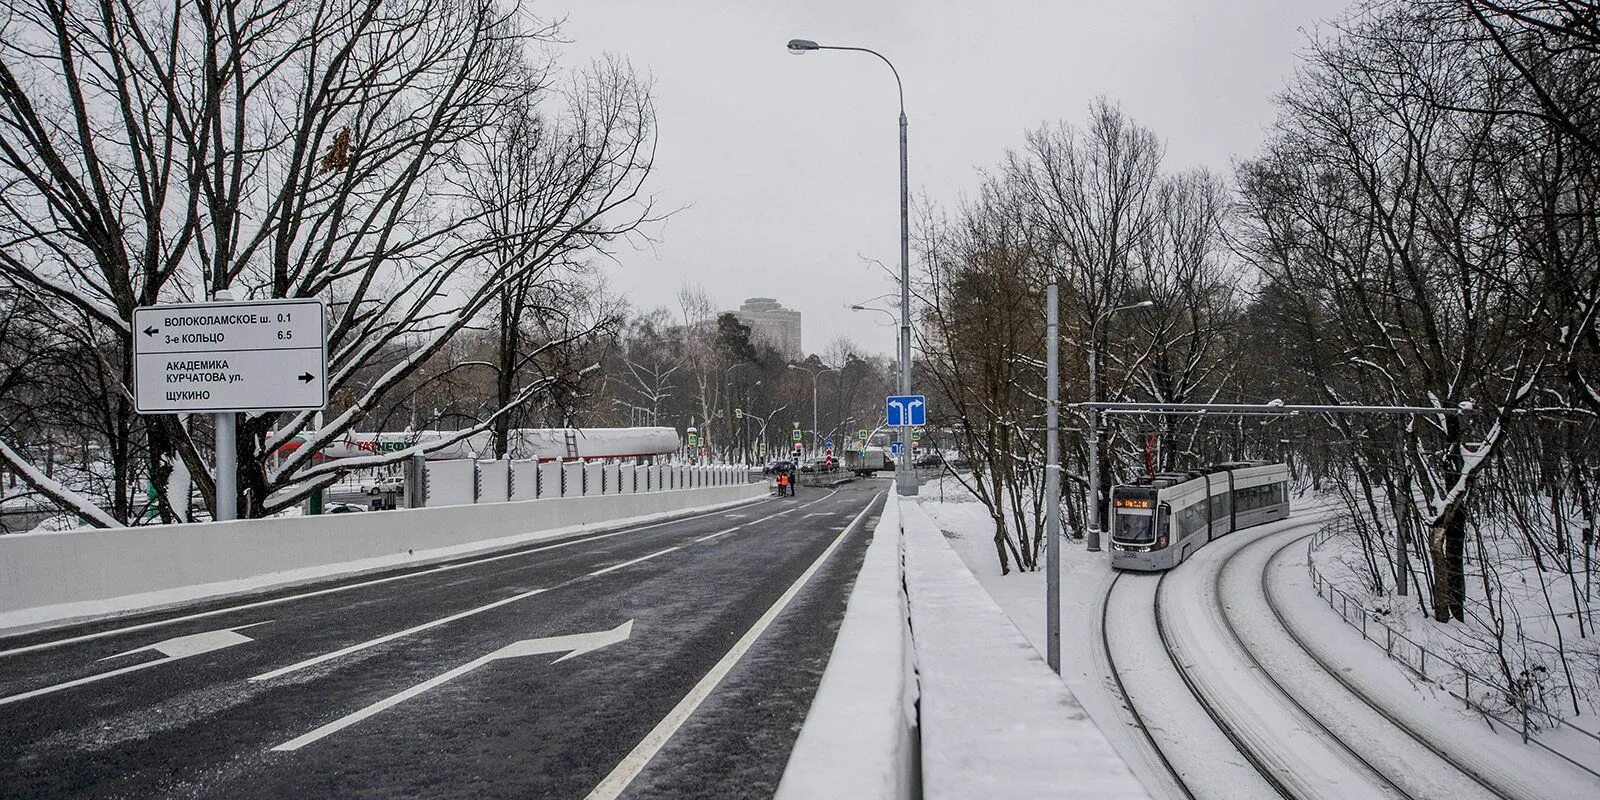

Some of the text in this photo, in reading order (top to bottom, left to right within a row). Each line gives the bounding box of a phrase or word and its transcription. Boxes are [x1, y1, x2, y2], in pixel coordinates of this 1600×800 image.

[164, 315, 257, 327] ВОЛОКОЛАМСКОЕ
[277, 313, 291, 322] 0.1
[165, 330, 292, 344] 3-е КОЛЬЦО 6.5
[166, 360, 229, 372] АКАДЕМИКА
[166, 372, 244, 384] КУРЧАТОВА ул.
[166, 390, 210, 402] ЩУКИНО
[356, 441, 416, 452] ТАТНЕФТ
